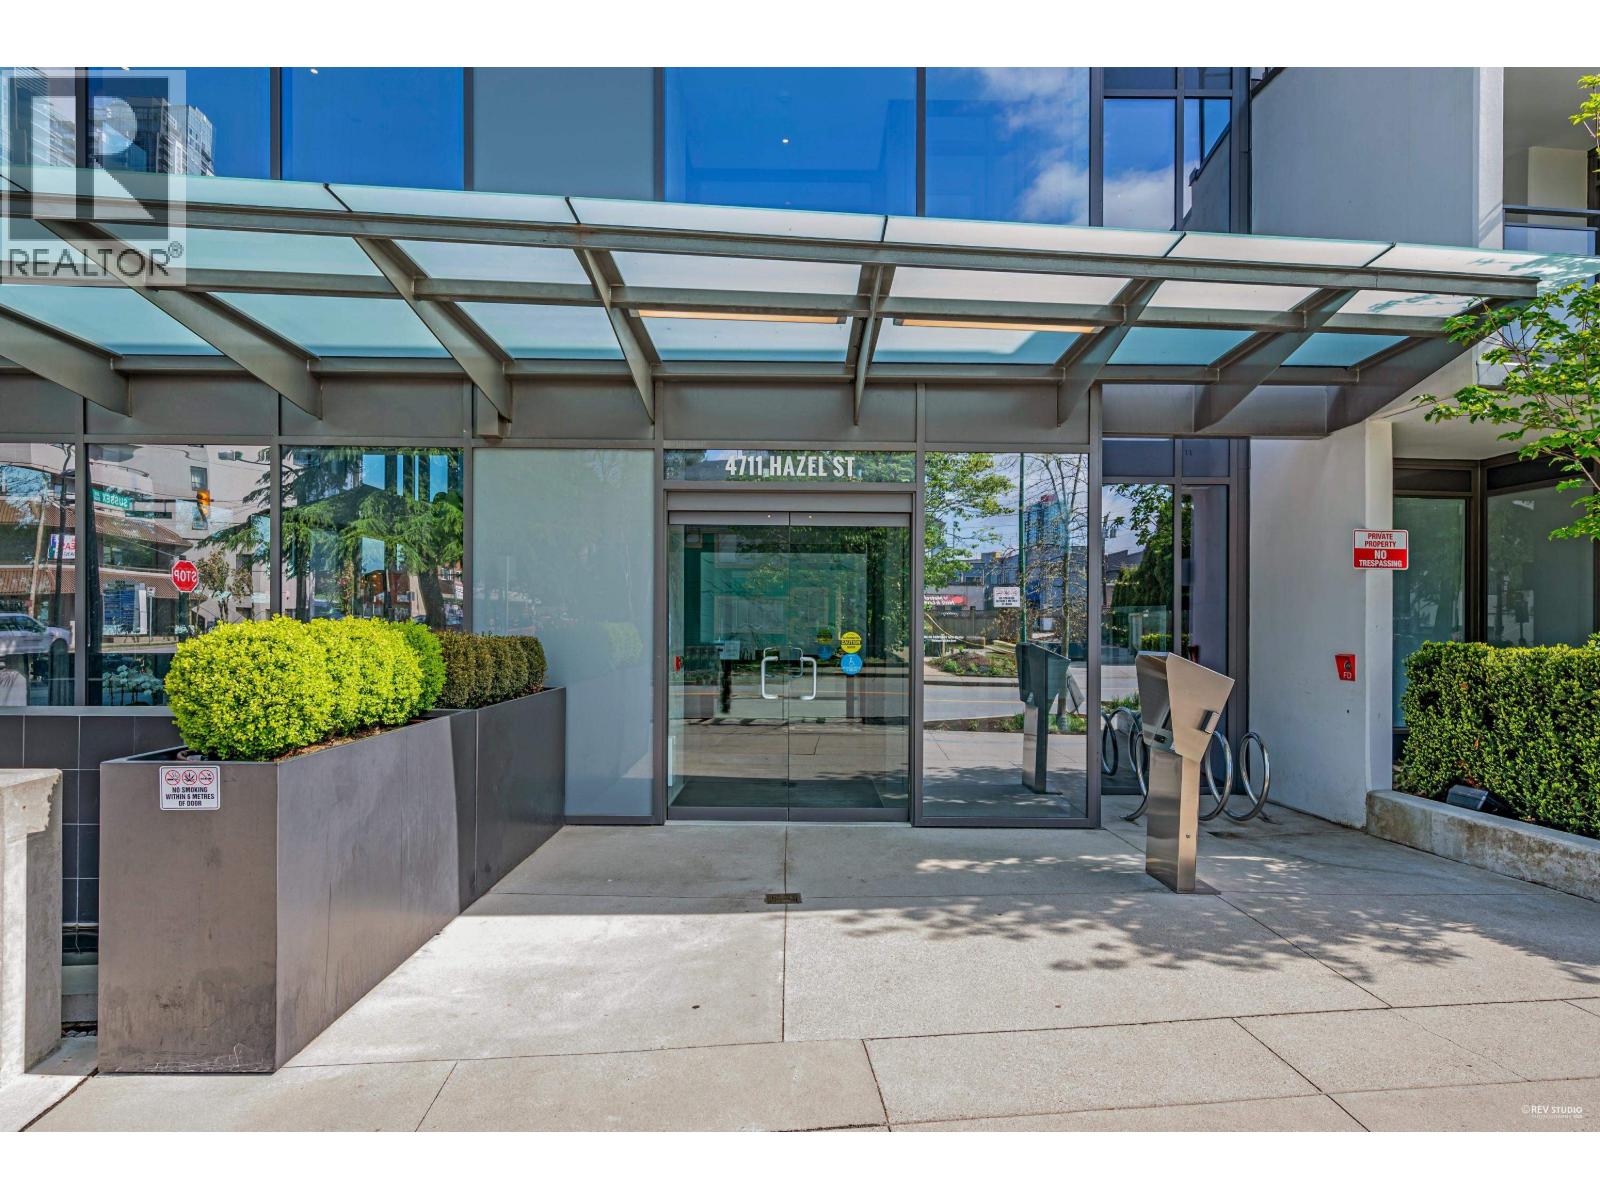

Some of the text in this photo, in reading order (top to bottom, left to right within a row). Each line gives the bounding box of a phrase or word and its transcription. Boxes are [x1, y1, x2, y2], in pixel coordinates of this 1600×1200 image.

[725, 455, 856, 478] 4711 HAZEL ST
[1374, 549, 1387, 560] NO
[1358, 559, 1402, 567] TRESPASSING
[1343, 671, 1352, 679] FD
